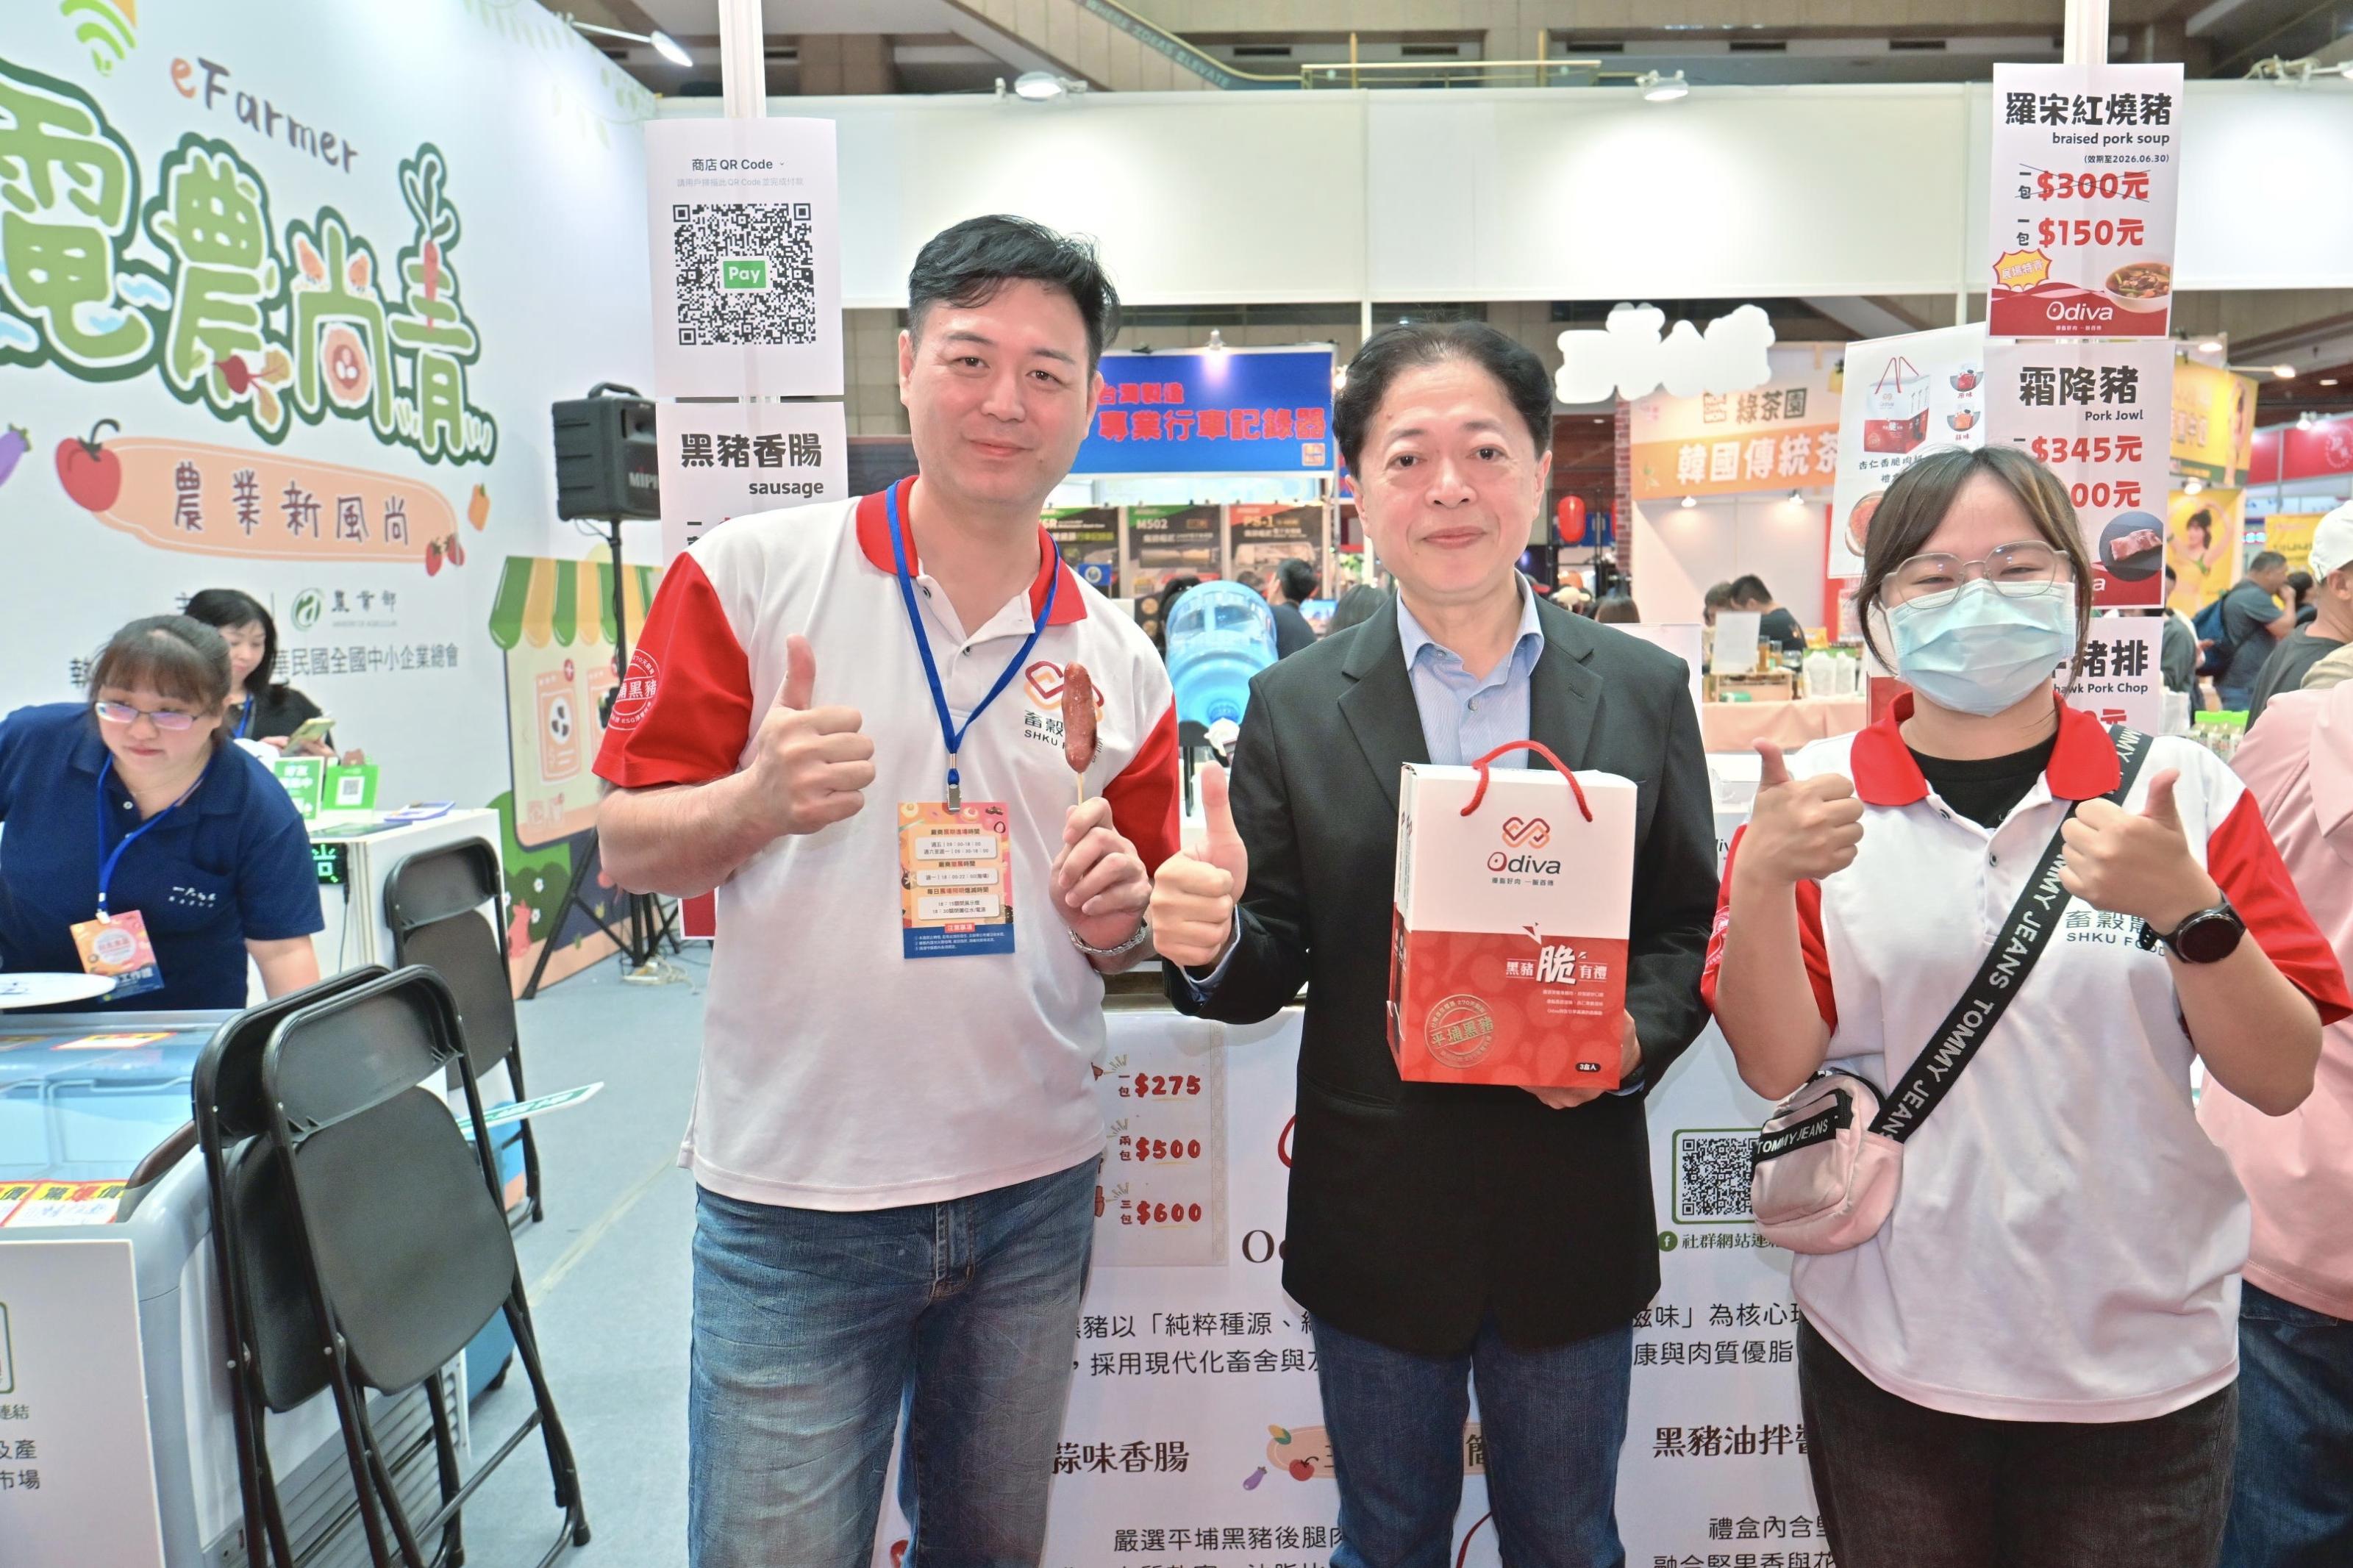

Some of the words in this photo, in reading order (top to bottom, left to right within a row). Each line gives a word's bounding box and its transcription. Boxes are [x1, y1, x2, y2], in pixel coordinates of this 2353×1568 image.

[169, 57, 358, 174] eFarmer
[2005, 92, 2171, 126] 羅宋紅燒豬
[2052, 132, 2099, 144] braised
[2103, 132, 2133, 147] pork
[2137, 135, 2170, 146] soup
[692, 158, 717, 171] 商店
[720, 159, 738, 170] QR
[741, 159, 773, 170] Code
[2084, 154, 2169, 164] (效期至2026.06.30)
[2037, 171, 2149, 201] $300元
[2038, 218, 2144, 248] $150元
[727, 265, 761, 284] Pay
[2046, 301, 2113, 321] Odiva
[2019, 365, 2138, 406] 霜降豬
[1736, 388, 1807, 424] 綠茶園
[2085, 410, 2112, 421] Pork
[2115, 409, 2143, 420] Jowl
[681, 433, 822, 468] 黑豬香腸
[2032, 436, 2142, 464] $345元
[174, 460, 409, 546] 農業新風尚
[749, 482, 824, 498] sausage
[1136, 519, 1168, 530] M502
[2088, 684, 2113, 693] Pork
[2118, 683, 2148, 695] Chop
[1024, 729, 1058, 746] SHKU
[1488, 852, 1561, 874] Odiva
[1989, 910, 2042, 989] JEANS
[2066, 932, 2116, 944] SHKU
[1506, 961, 1535, 977] 黑豬
[1536, 944, 1577, 985] 脆
[1579, 963, 1608, 980] 有禮
[1927, 999, 1994, 1083] TOMMY
[1135, 1073, 1201, 1098] $275
[1135, 1136, 1201, 1161] $500
[1757, 1131, 1799, 1155] TOMMY
[1796, 1118, 1829, 1140] JEANS
[1137, 1200, 1202, 1225] $600
[1076, 1311, 1313, 1339] 豬以「純粹種源、
[1634, 1339, 1794, 1366] 康與肉質優脂
[1052, 1440, 1190, 1475] 蒜味香腸
